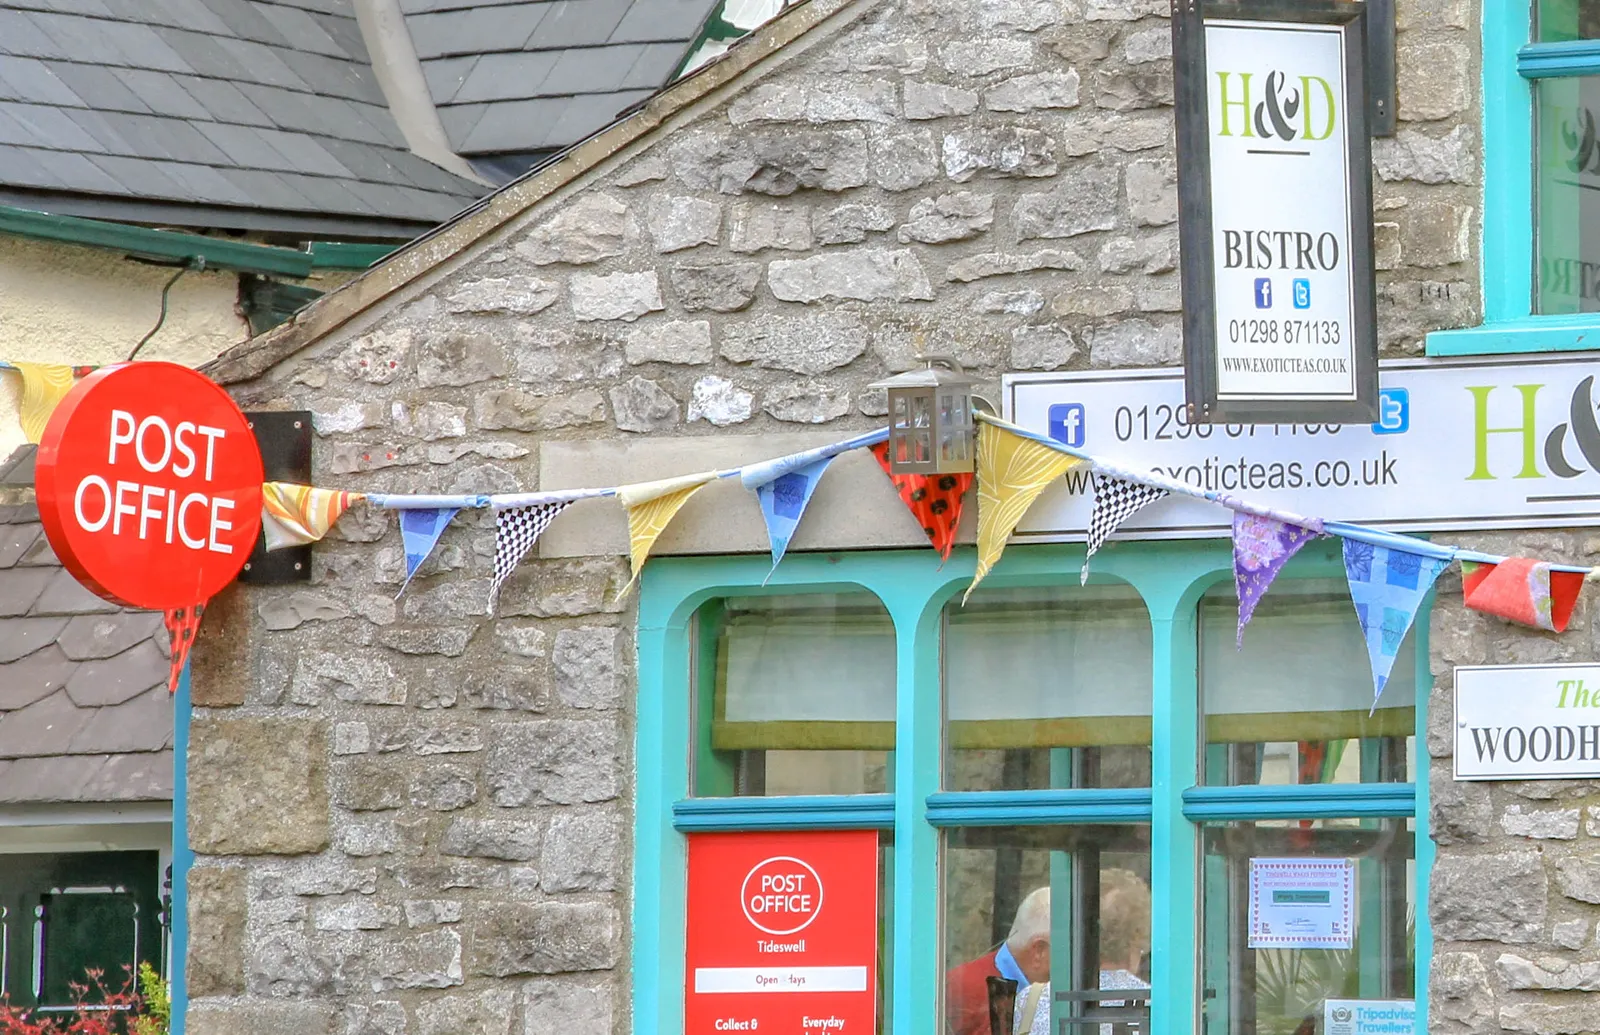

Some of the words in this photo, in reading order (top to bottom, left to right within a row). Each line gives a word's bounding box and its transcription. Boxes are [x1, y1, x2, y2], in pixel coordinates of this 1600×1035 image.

[1215, 70, 1335, 141] H&D
[1221, 229, 1340, 271] BISTRO
[1229, 319, 1279, 343] 01298
[1284, 320, 1341, 345] 871133
[1223, 357, 1347, 373] WWW.EXOTICTEAS.CO.UK
[108, 409, 226, 481] POST
[74, 474, 235, 554] OFFICE
[761, 874, 806, 893] POST
[750, 895, 811, 913] OFFICE
[757, 940, 805, 953] Tideswell
[755, 974, 778, 987] Open
[715, 1018, 748, 1030] Collect
[751, 1018, 758, 1030] &
[802, 1015, 845, 1031] Everyday
